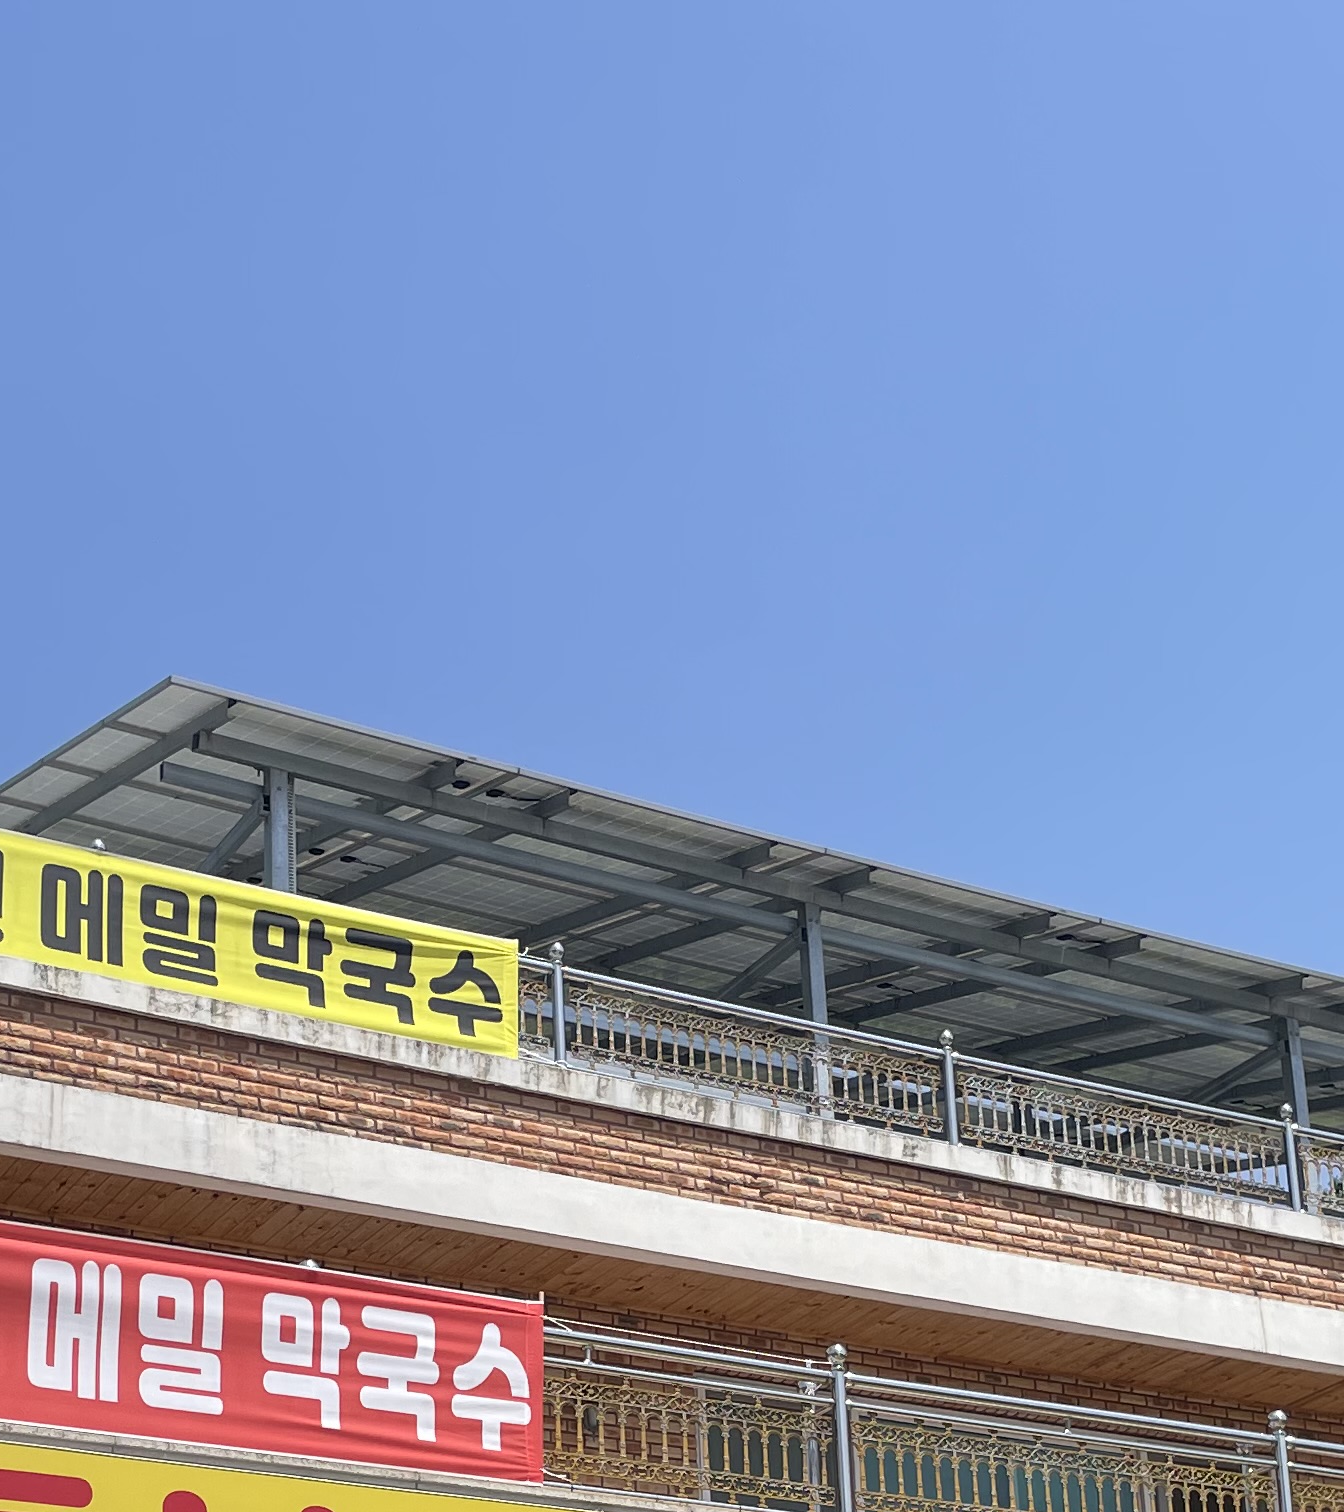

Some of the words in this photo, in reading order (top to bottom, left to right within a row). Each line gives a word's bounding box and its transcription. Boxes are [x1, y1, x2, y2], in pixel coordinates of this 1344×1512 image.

[41, 864, 218, 986] 메밀
[253, 910, 503, 1036] 막국수
[27, 1258, 224, 1415] 메밀
[261, 1292, 532, 1452] 막국수
